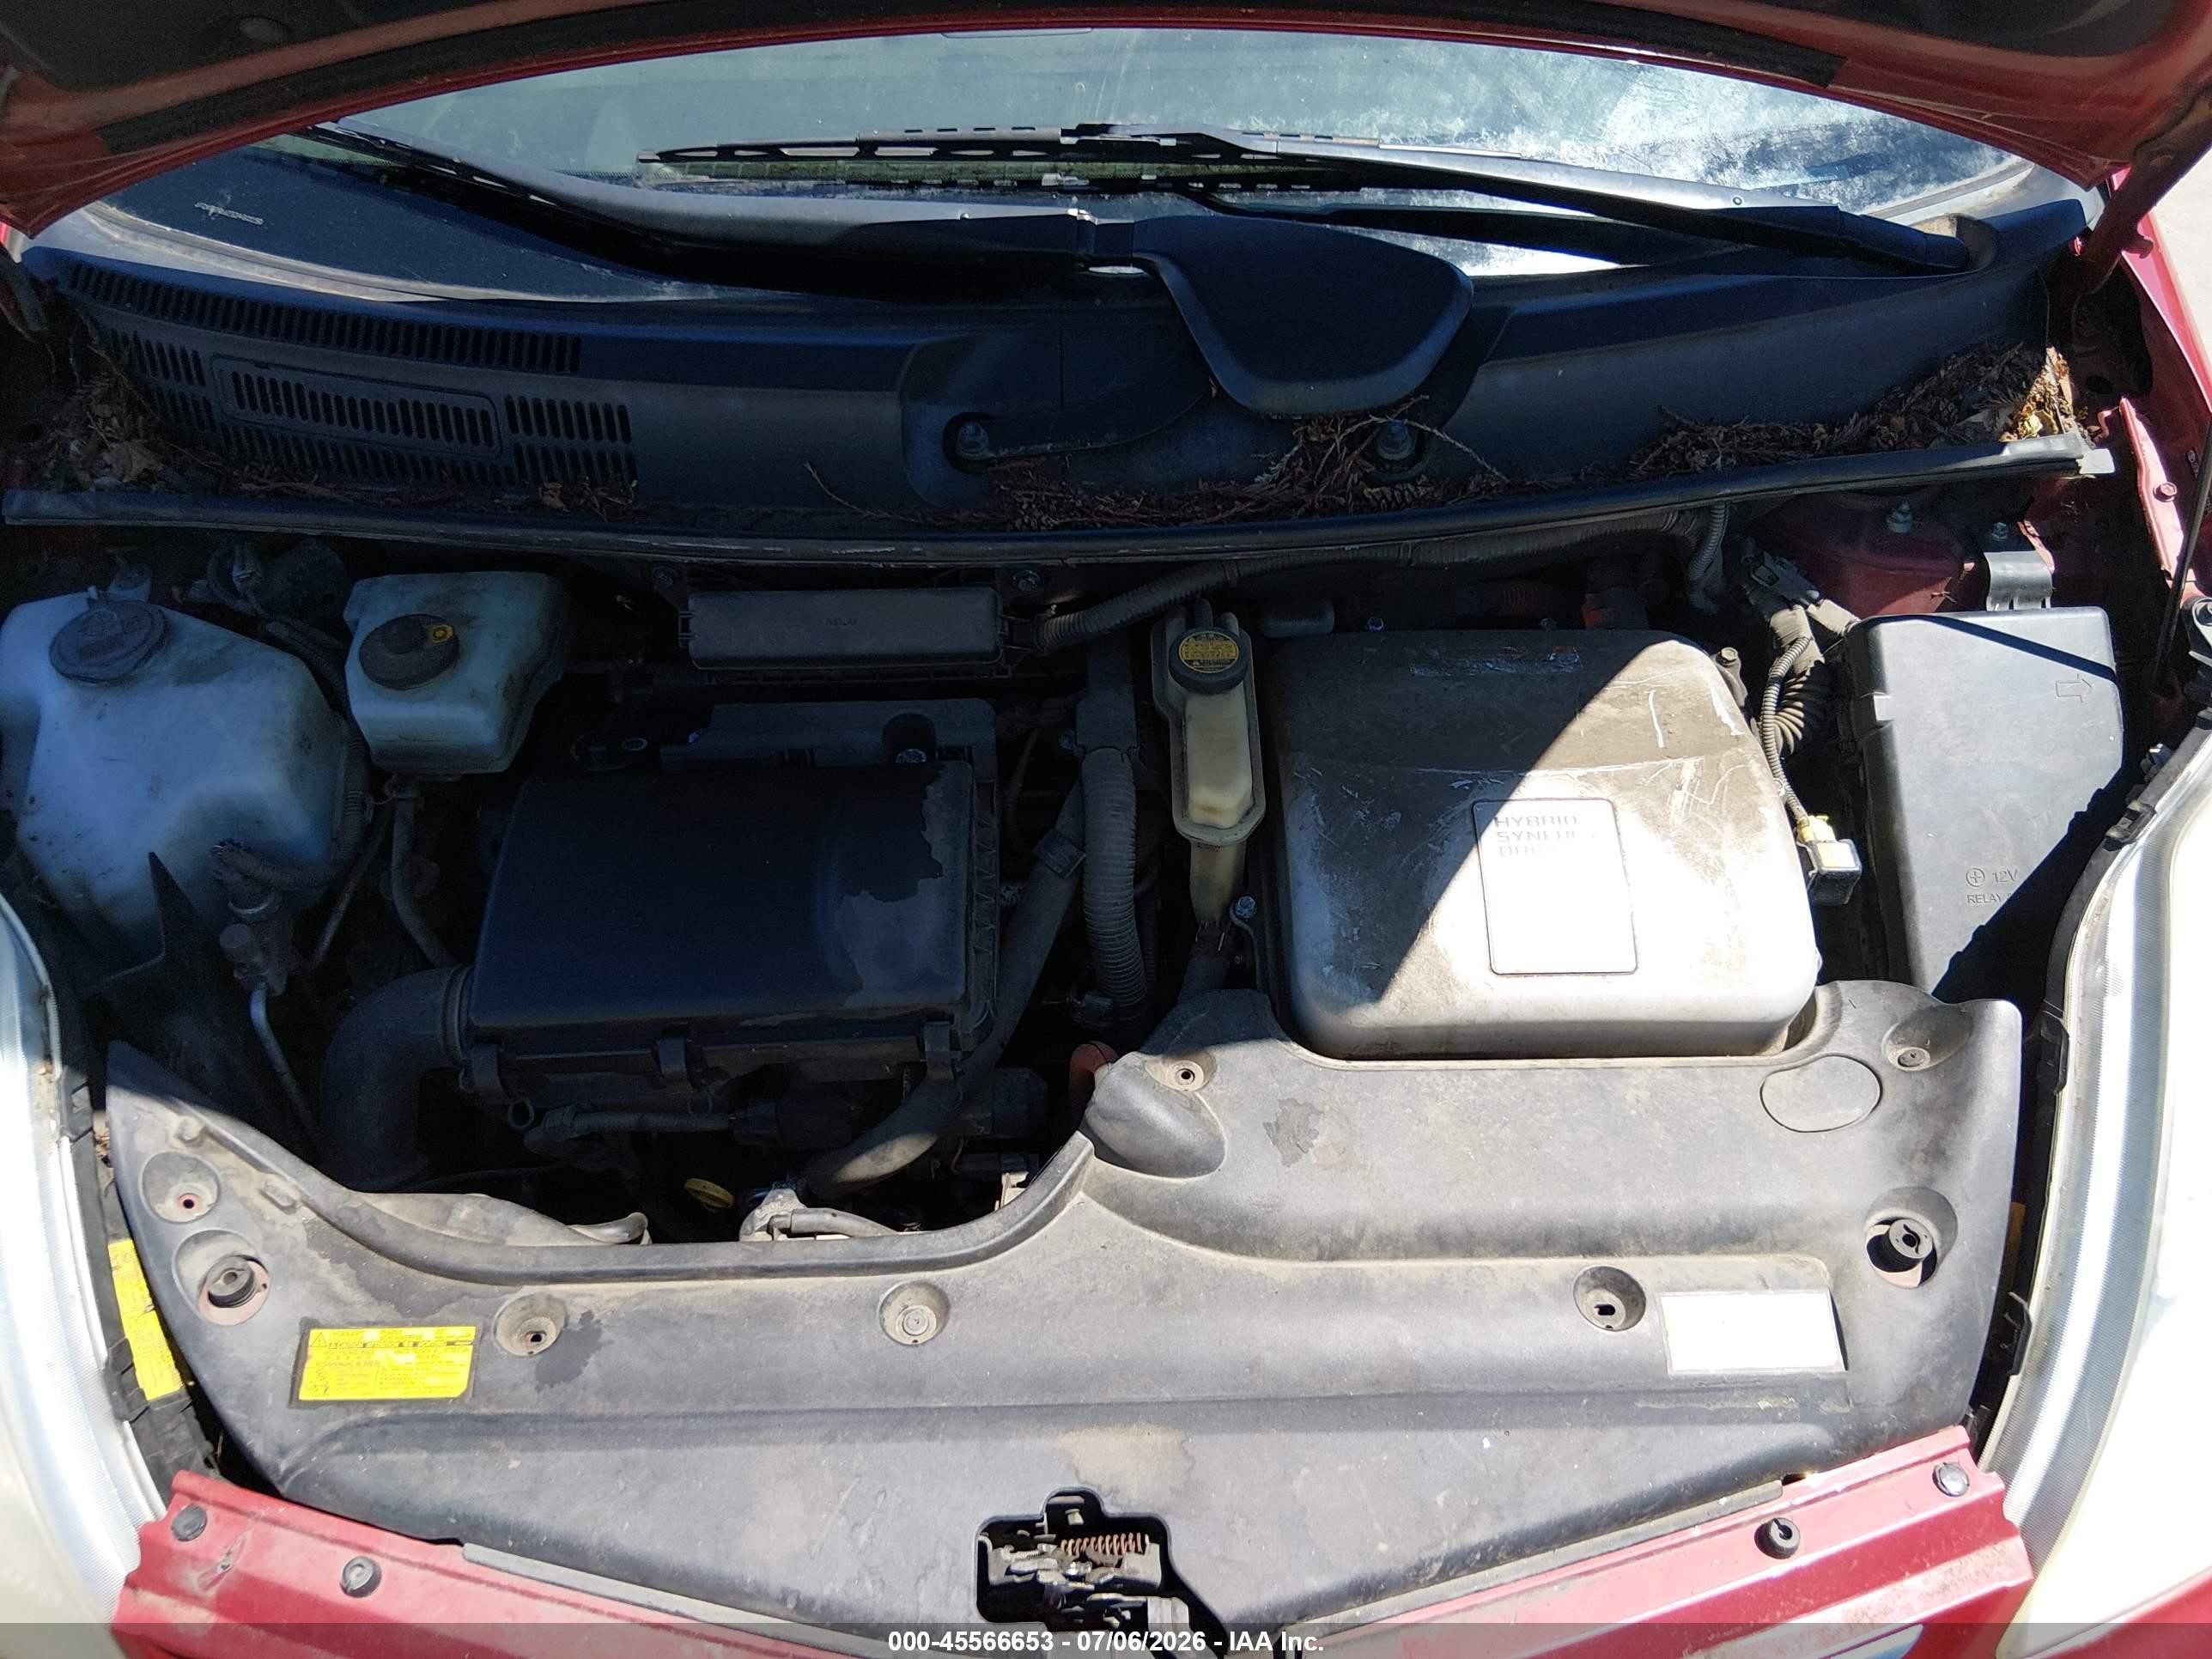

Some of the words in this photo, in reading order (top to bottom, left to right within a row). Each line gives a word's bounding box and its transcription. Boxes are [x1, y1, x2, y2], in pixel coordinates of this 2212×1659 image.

[1494, 816, 1577, 828] HYBRID
[1497, 830, 1598, 842] SYNR
[1498, 846, 1558, 857] DRI
[1991, 868, 2019, 883] 12V
[1967, 892, 2002, 904] RELAY
